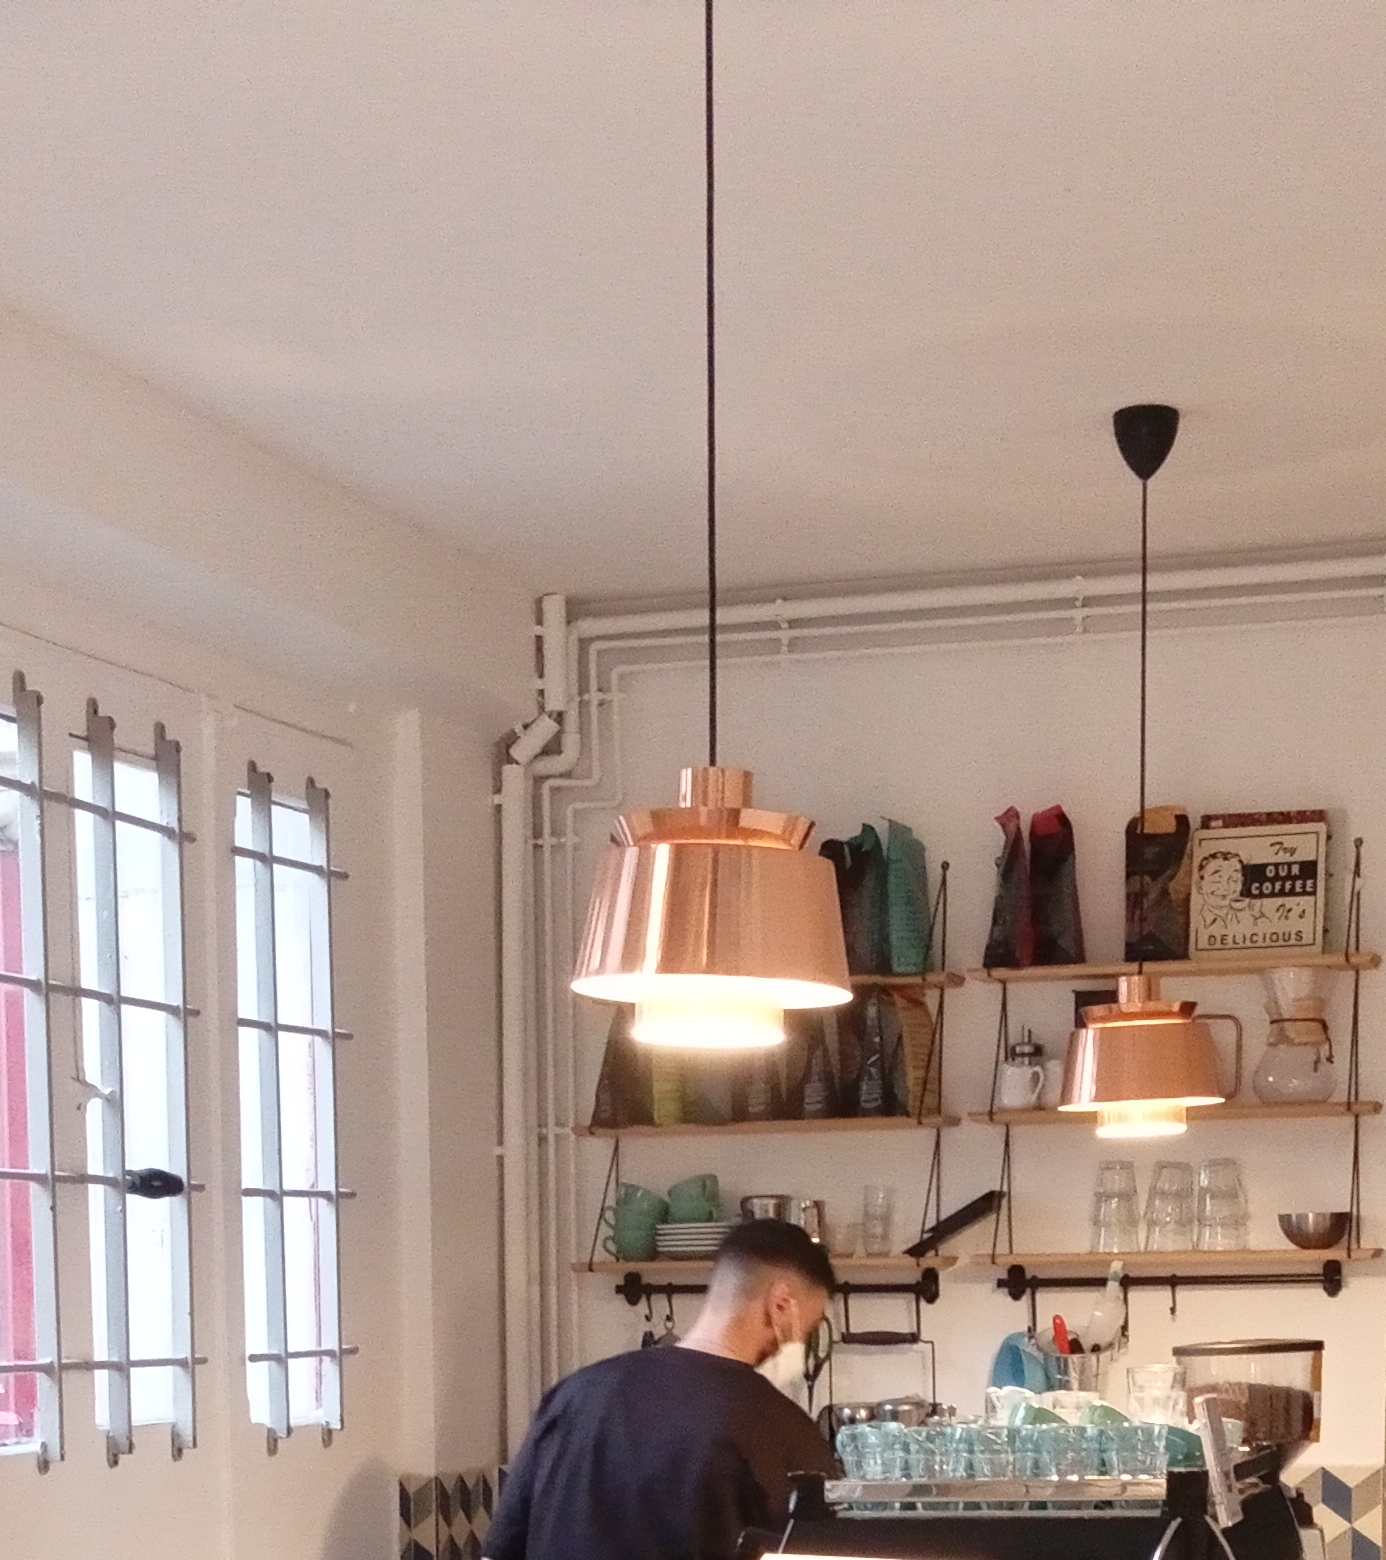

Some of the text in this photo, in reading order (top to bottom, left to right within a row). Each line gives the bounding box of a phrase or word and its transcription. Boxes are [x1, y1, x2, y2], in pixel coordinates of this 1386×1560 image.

[1265, 863, 1300, 878] OUR
[1250, 879, 1314, 896] COFFEE
[1275, 902, 1306, 921] It's
[1207, 930, 1305, 947] DELICIOUS
